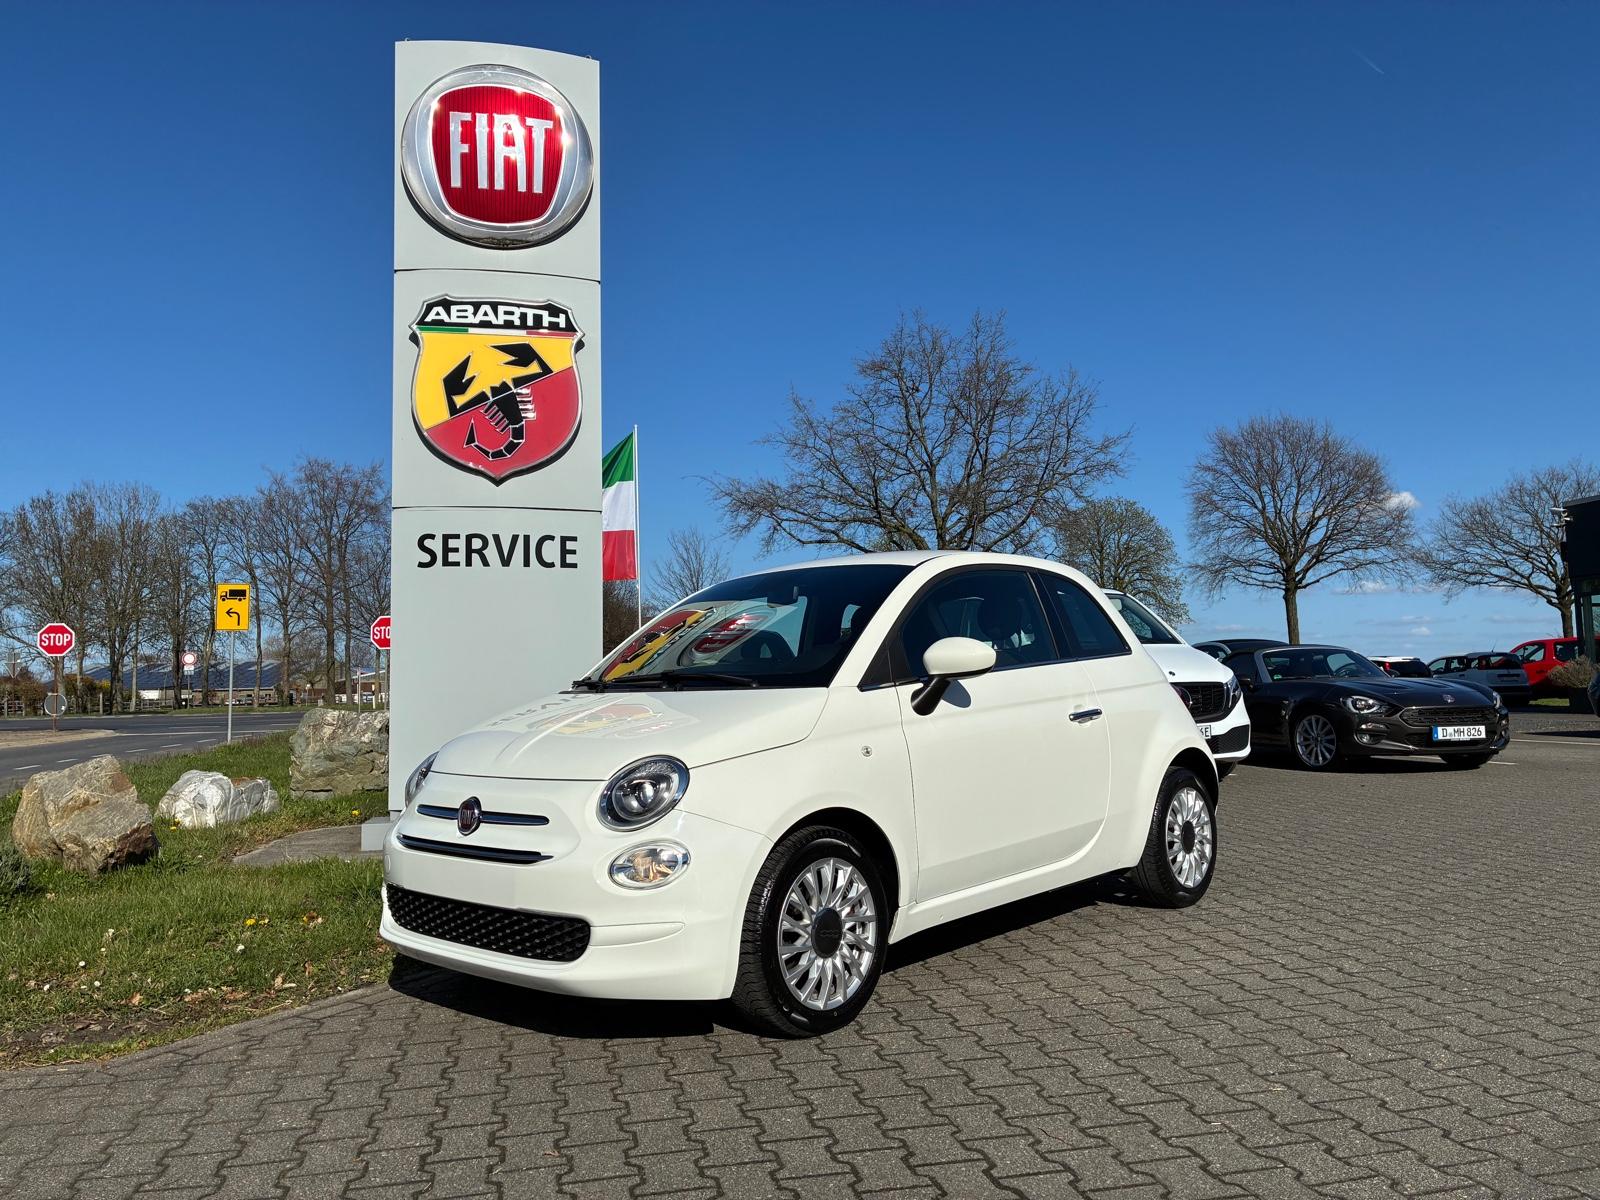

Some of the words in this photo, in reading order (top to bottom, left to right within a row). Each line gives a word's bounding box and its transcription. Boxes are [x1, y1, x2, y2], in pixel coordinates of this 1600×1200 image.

[449, 111, 554, 194] FIAT
[424, 304, 567, 329] ABARTH
[416, 532, 579, 569] SERVICE
[41, 633, 71, 647] STOP
[373, 626, 391, 640] STO
[1441, 727, 1448, 738] D
